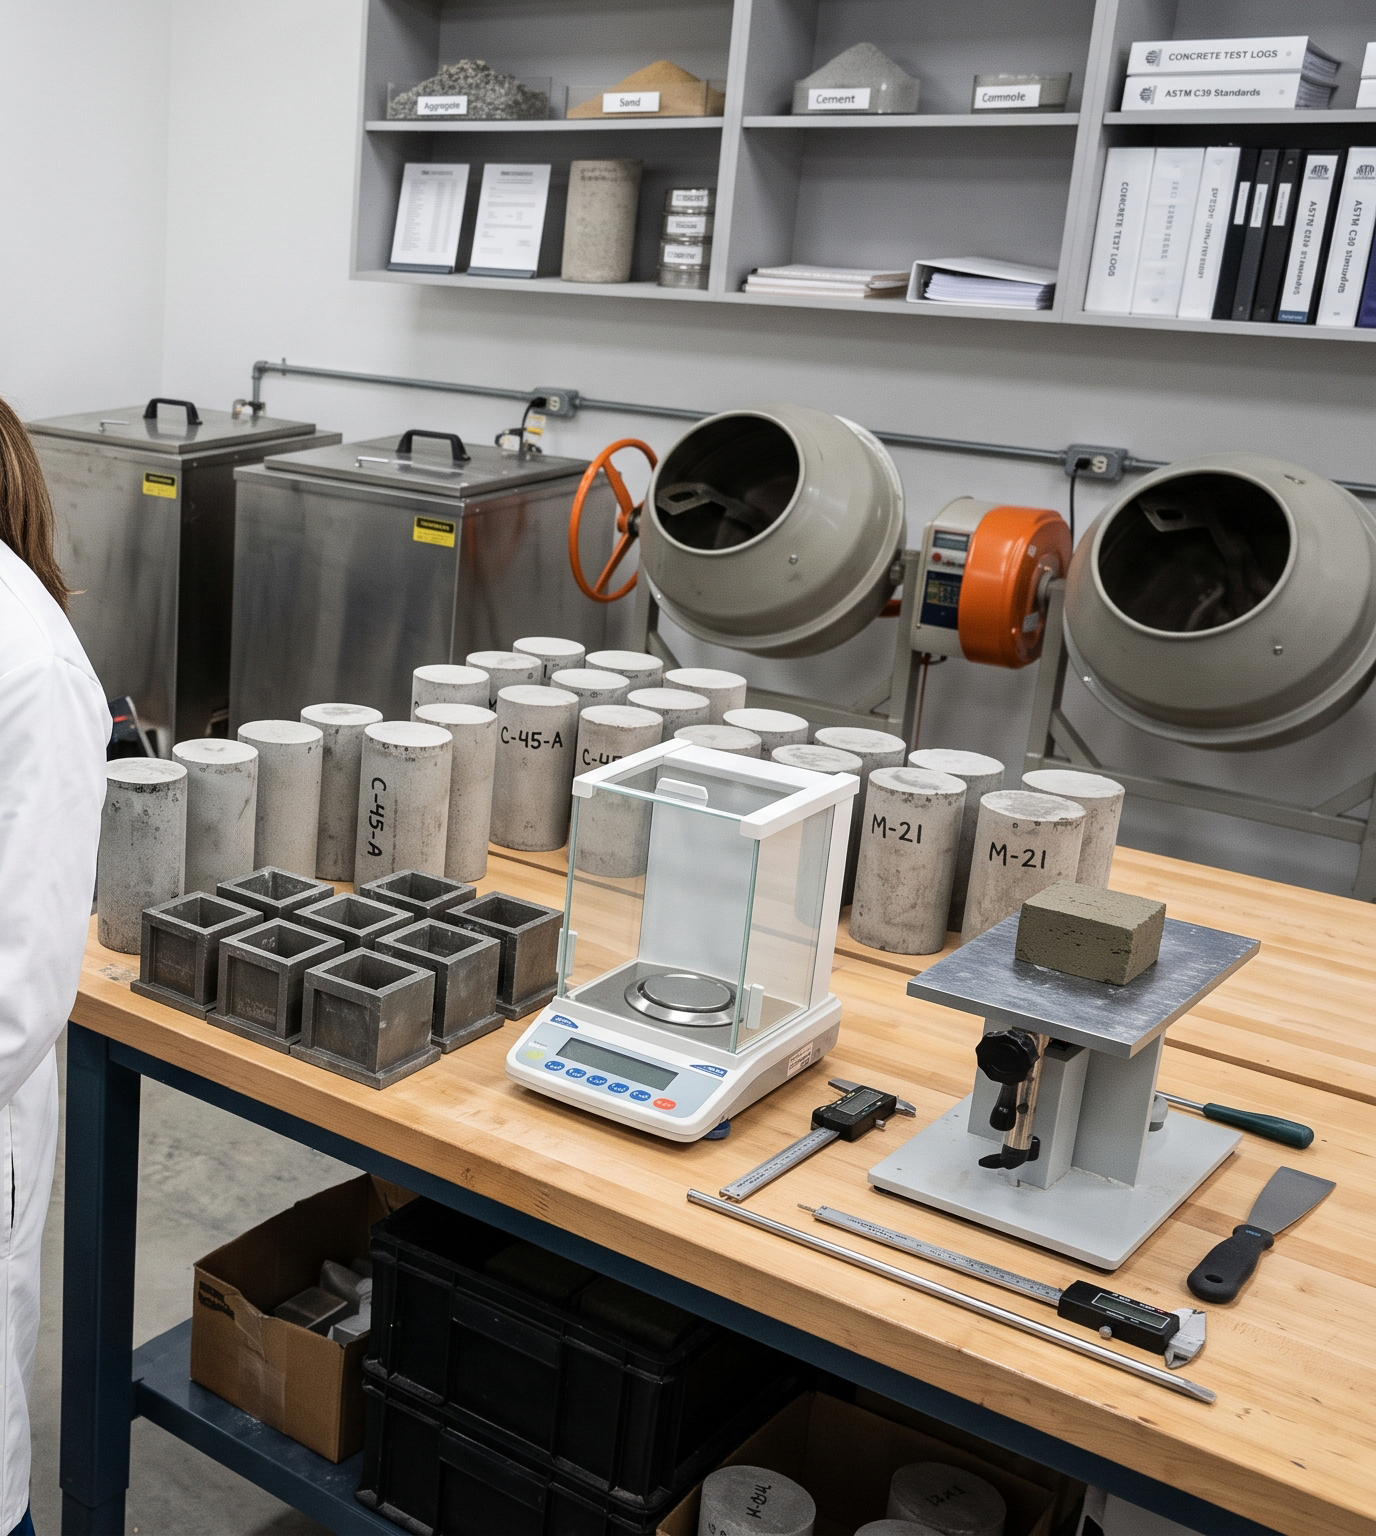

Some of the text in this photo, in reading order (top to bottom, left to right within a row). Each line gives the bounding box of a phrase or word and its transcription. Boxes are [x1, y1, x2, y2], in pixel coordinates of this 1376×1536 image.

[1168, 49, 1278, 61] CONCRETE TEST LOGS
[815, 93, 856, 104] Cement
[1165, 88, 1261, 98] ASTM C39 Standards
[500, 725, 564, 750] C-45-A
[368, 776, 387, 857] C-45-A
[871, 813, 923, 844] M-21
[988, 841, 1047, 870] M-21
